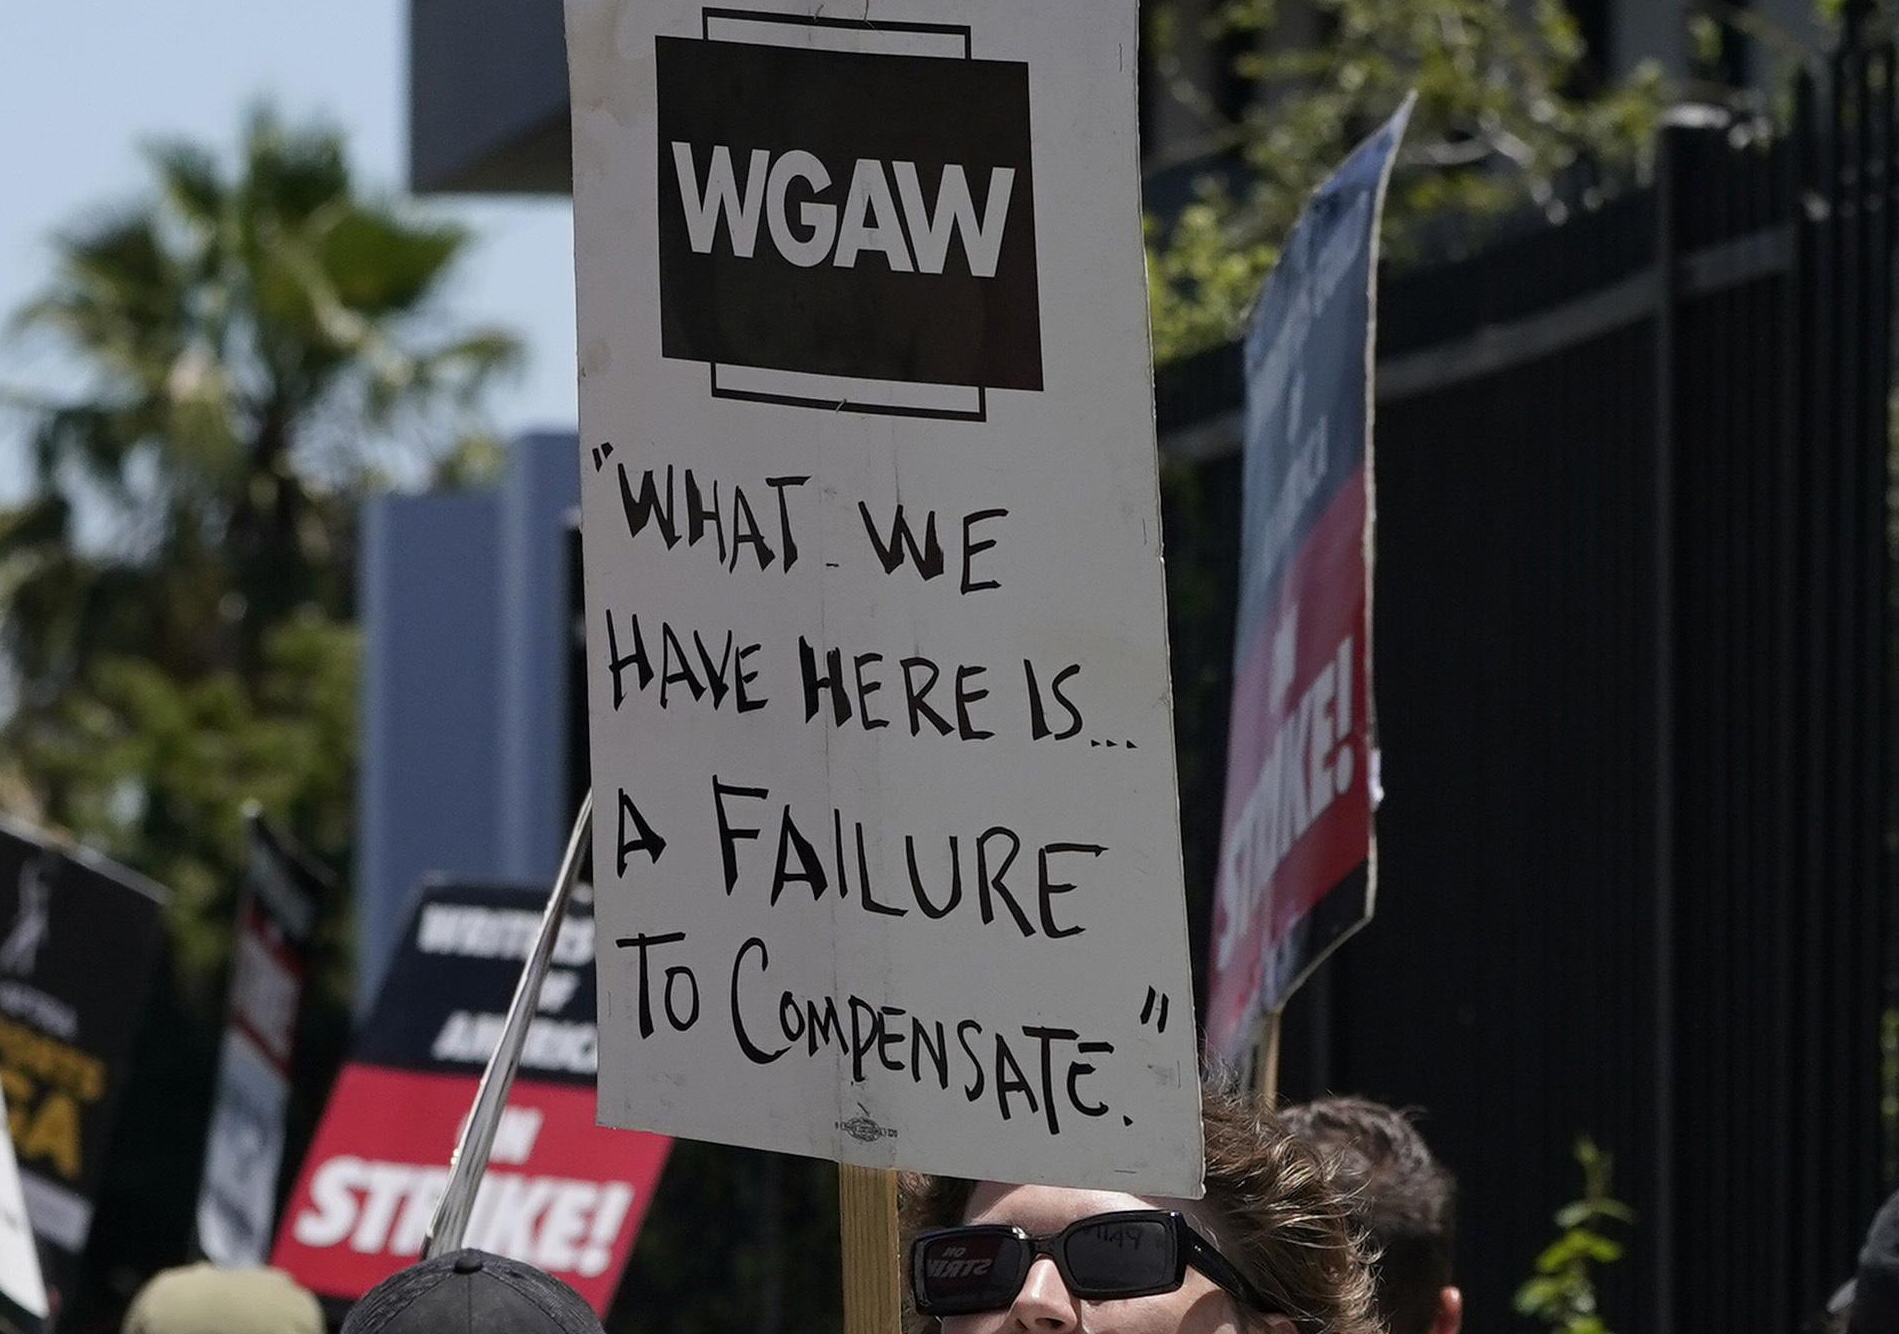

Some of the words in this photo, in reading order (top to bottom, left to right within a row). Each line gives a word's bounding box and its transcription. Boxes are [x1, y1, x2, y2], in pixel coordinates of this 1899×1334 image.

[671, 141, 1015, 278] WGAW
[858, 500, 1009, 595] WE
[606, 609, 770, 713] HAVE
[799, 635, 996, 742] HERE
[617, 787, 668, 879] A
[711, 774, 1110, 938] FAILURE
